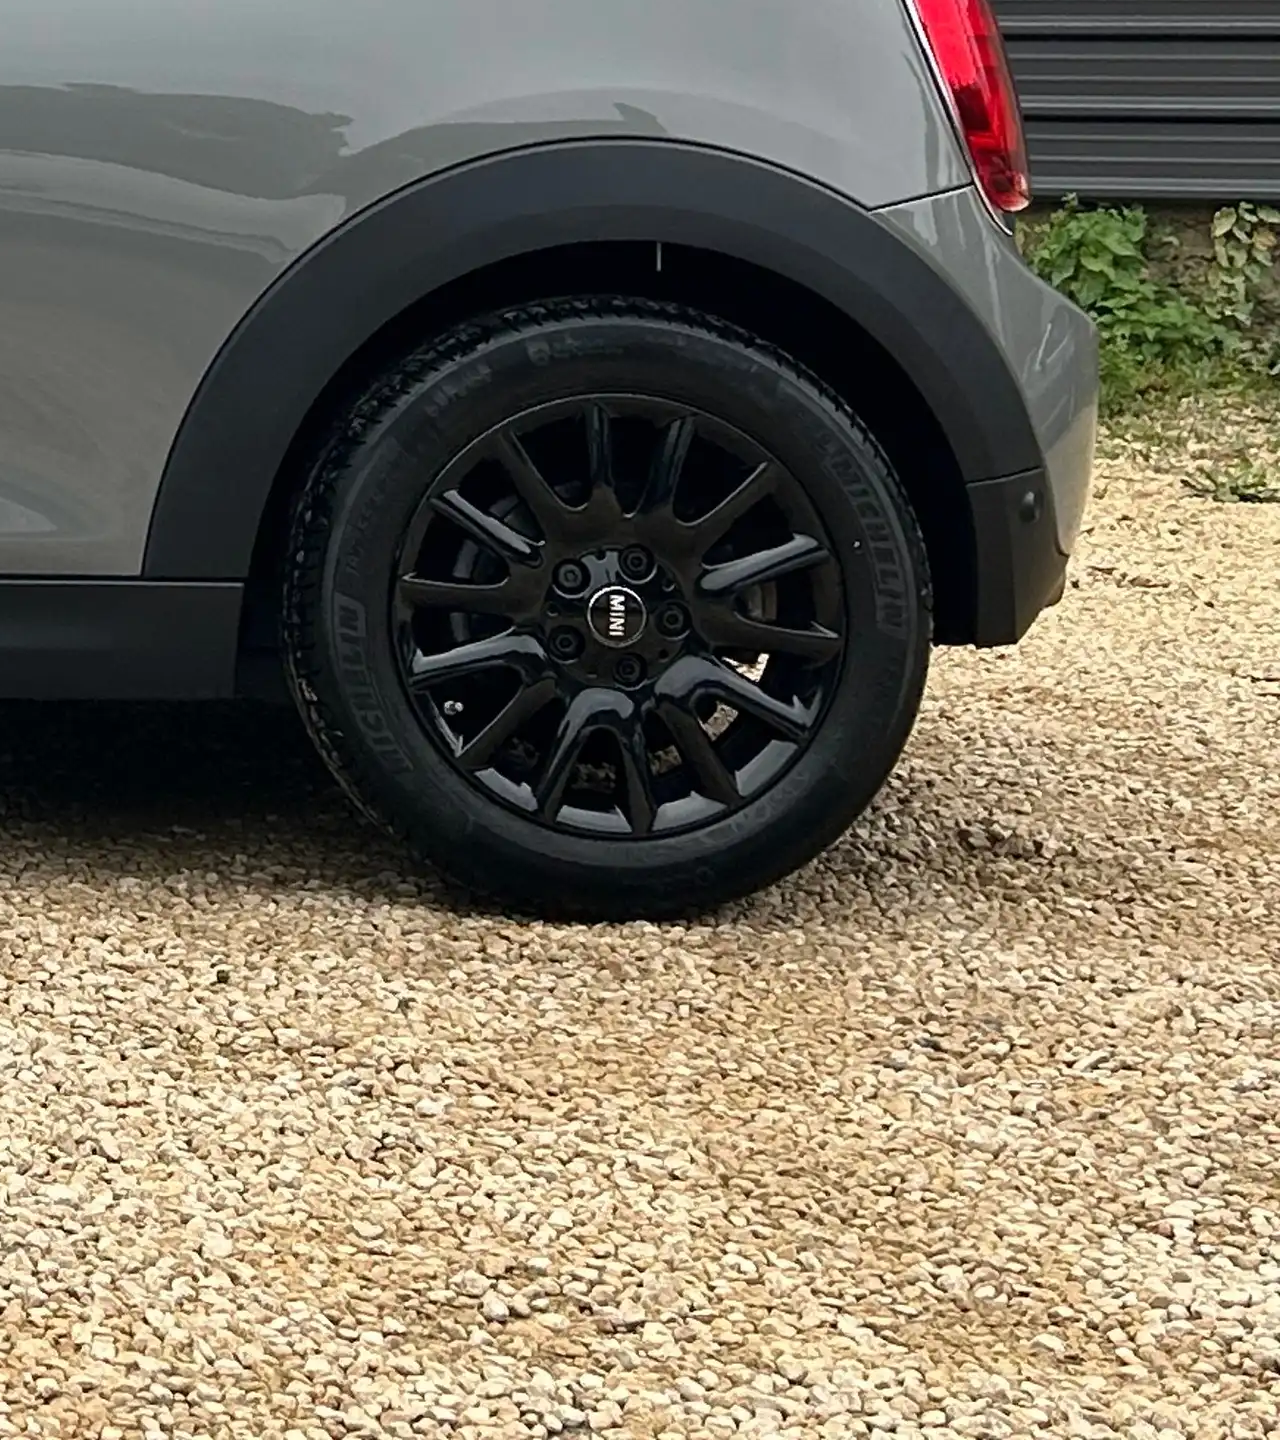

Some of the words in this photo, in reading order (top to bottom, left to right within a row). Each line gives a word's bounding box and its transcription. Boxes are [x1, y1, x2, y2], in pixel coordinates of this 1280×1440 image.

[609, 595, 626, 636] MINI
[827, 457, 906, 629] MICHELIN
[335, 598, 416, 773] MICHELIN
